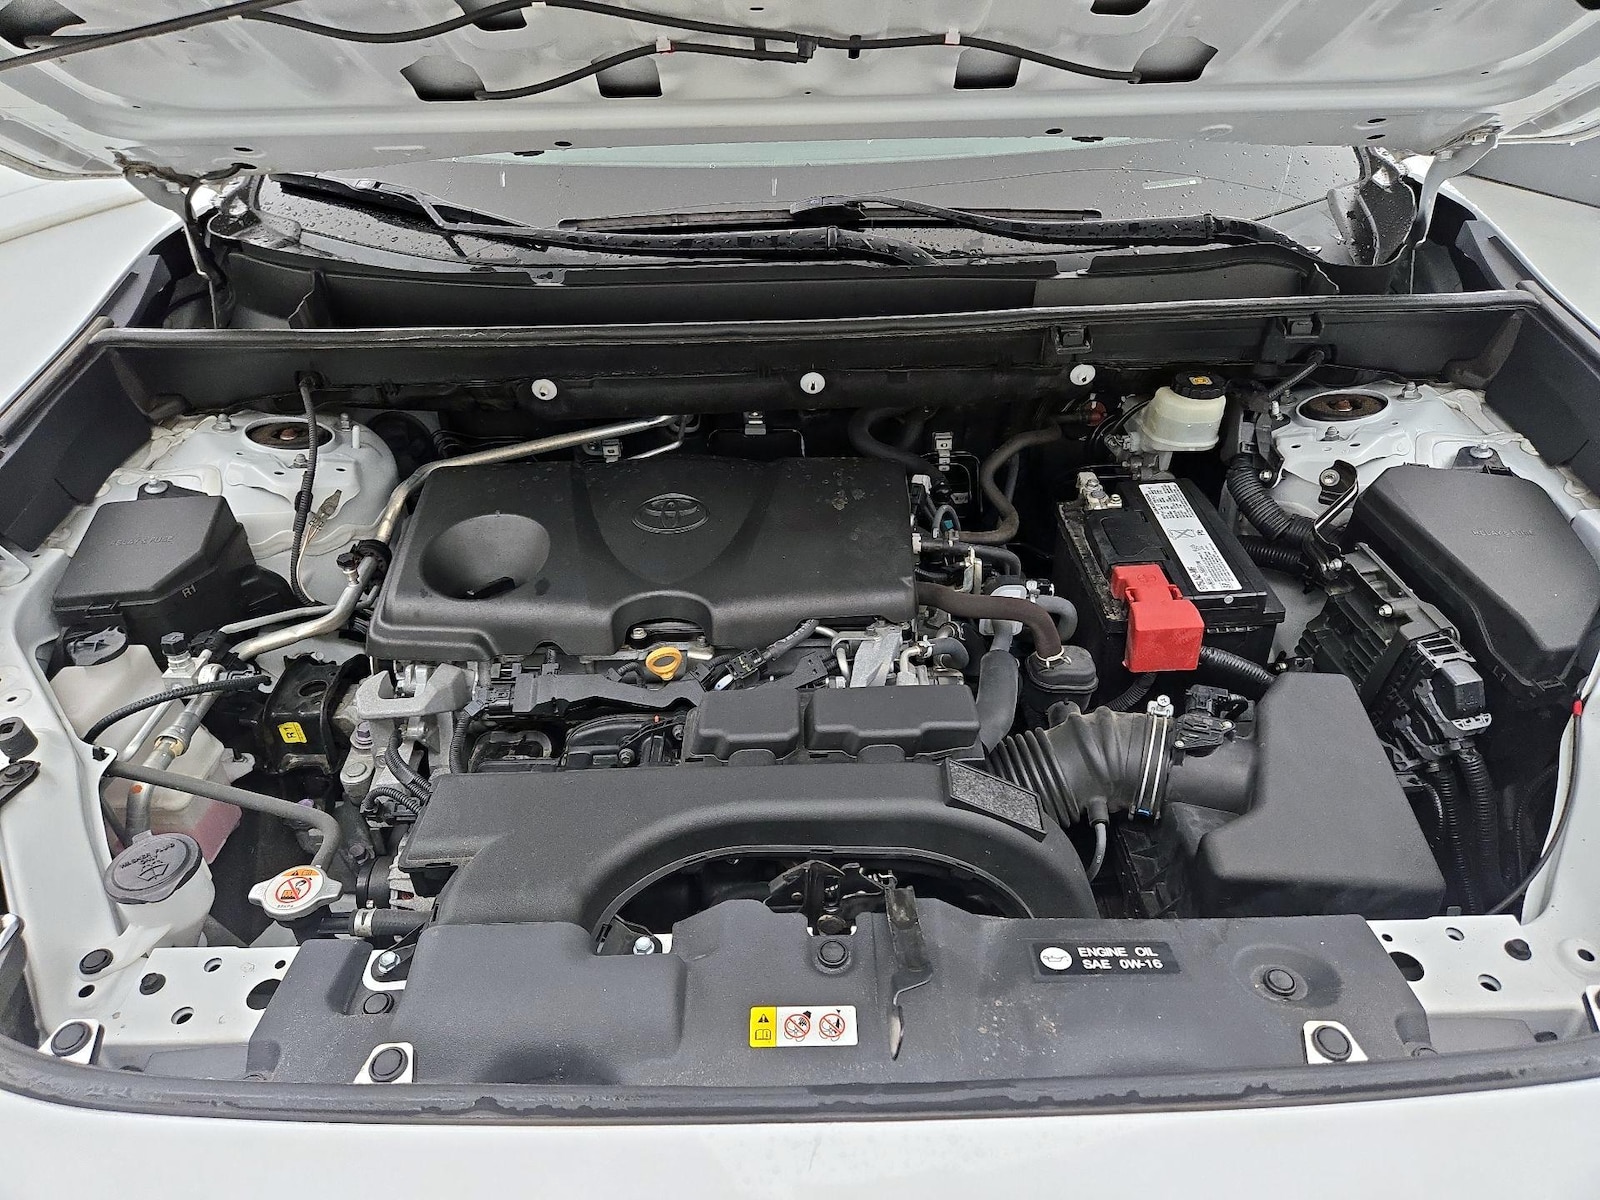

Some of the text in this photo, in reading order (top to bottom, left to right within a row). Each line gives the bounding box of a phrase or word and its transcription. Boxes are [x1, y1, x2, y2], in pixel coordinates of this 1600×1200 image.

[182, 584, 197, 598] R1
[283, 726, 297, 739] R1
[119, 842, 176, 869] WASHER FLUID
[1077, 946, 1159, 957] ENGINE OIL
[1082, 959, 1164, 970] SAE 0W-16
